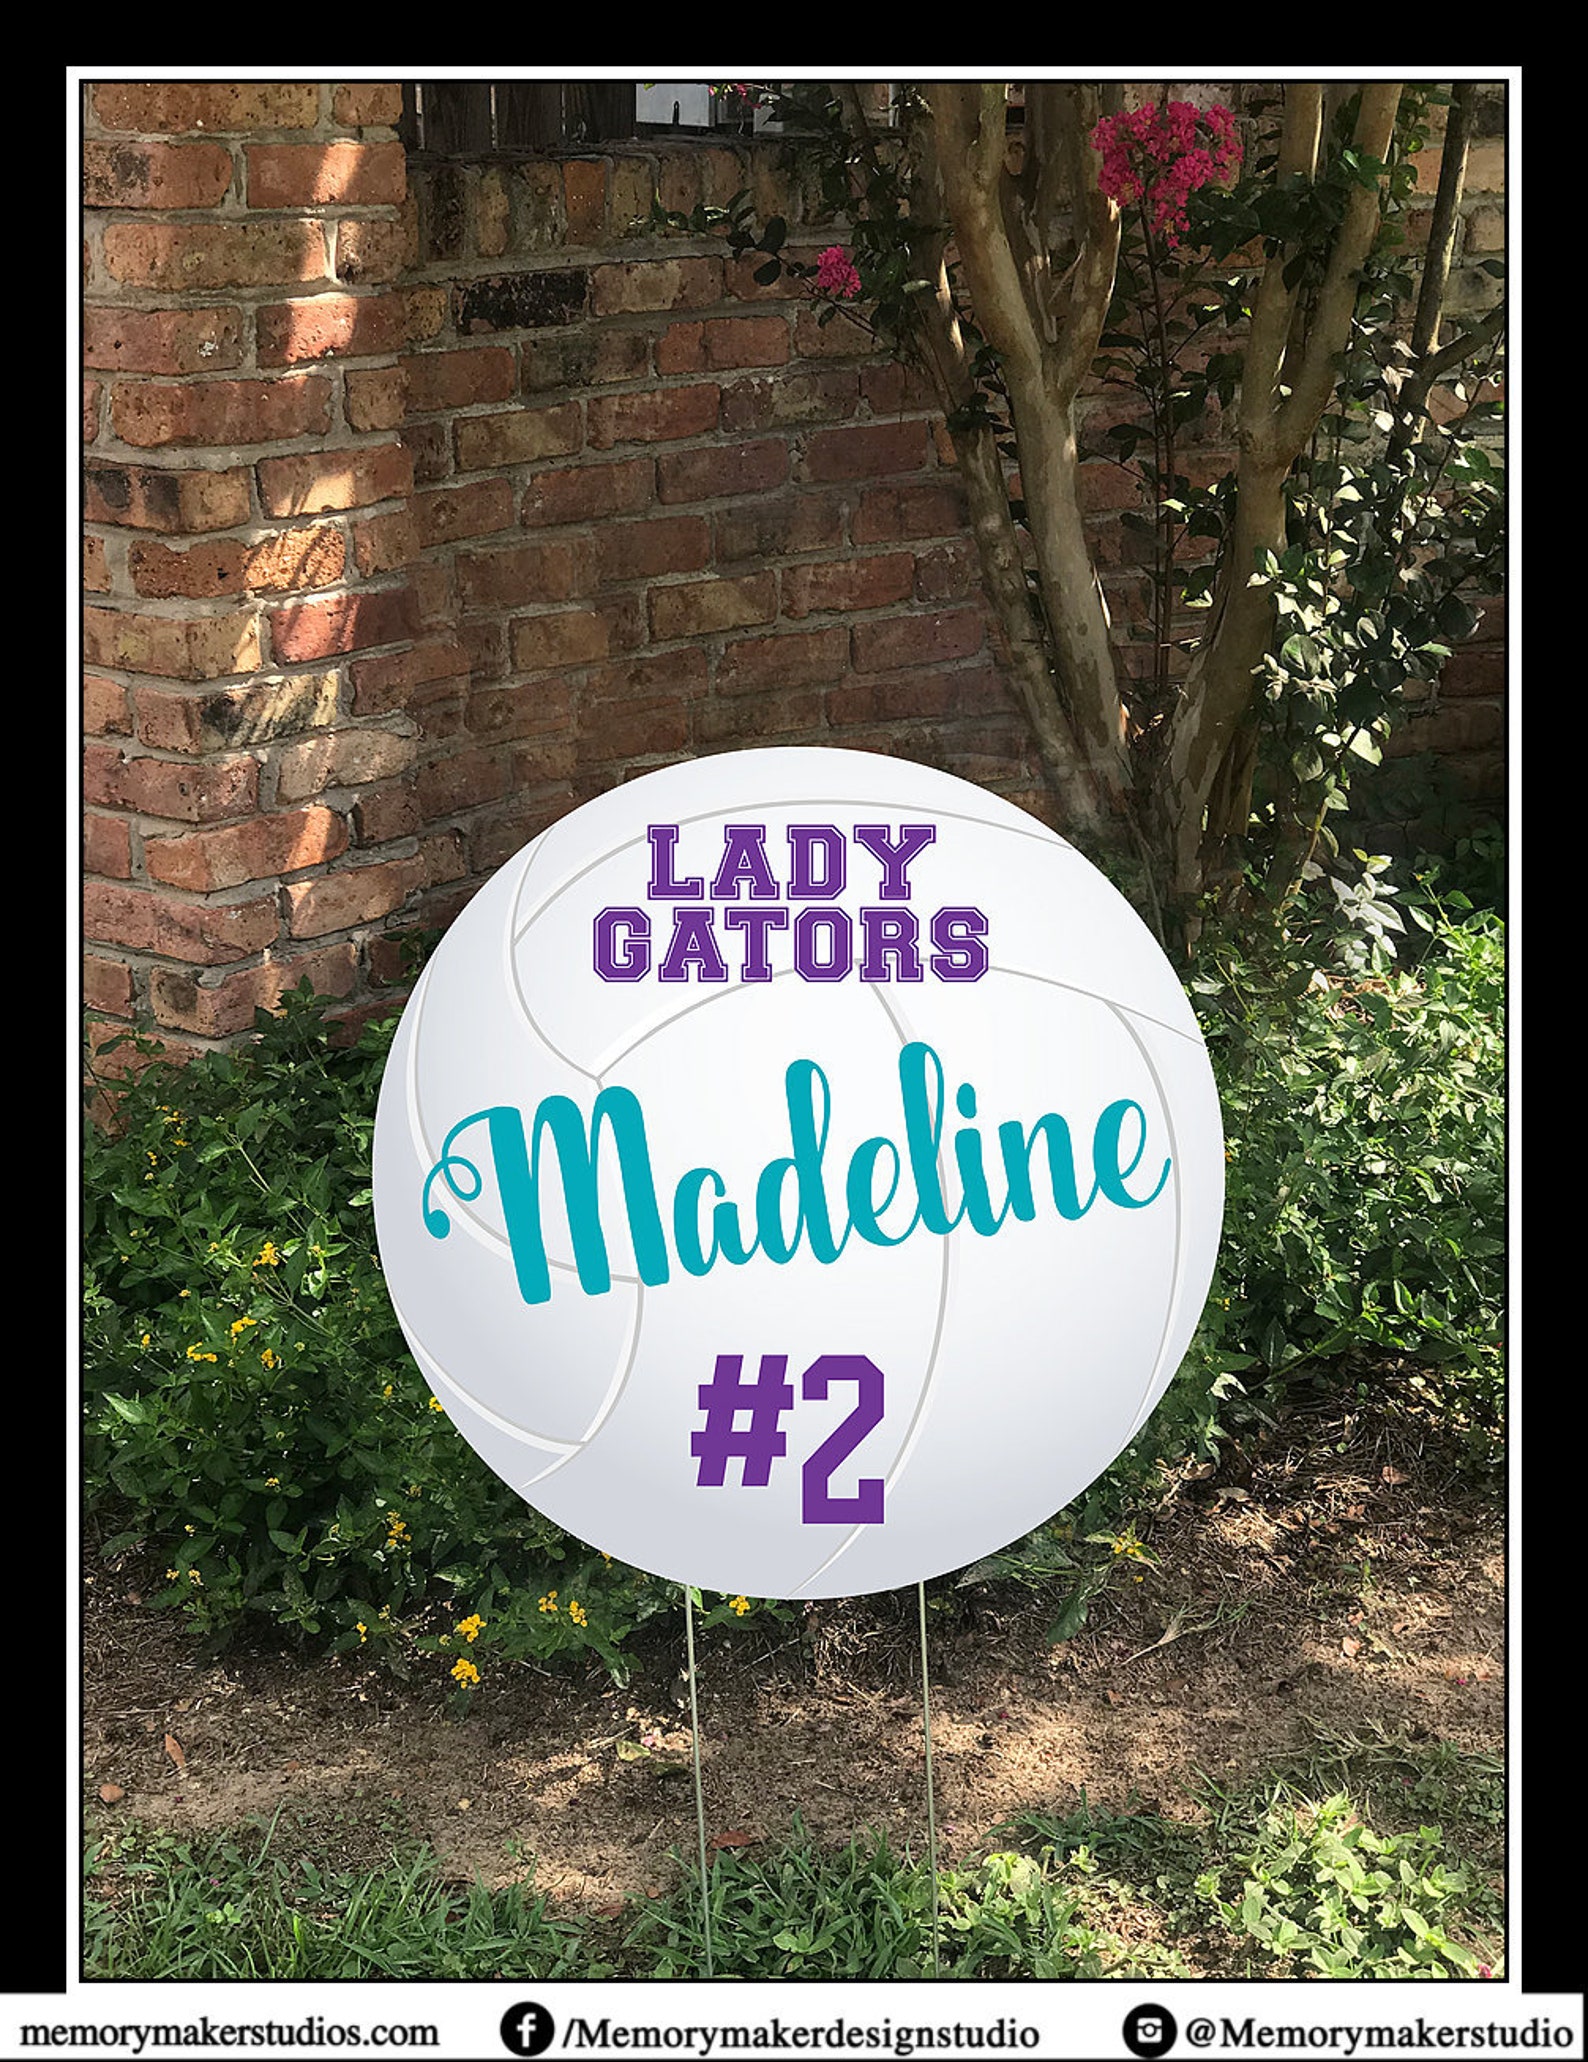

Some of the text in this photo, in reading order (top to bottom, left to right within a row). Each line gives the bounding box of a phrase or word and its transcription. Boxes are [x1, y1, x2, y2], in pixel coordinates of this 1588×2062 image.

[647, 824, 937, 901] LADY
[593, 907, 989, 983] GATORS
[423, 1041, 1172, 1305] Madeline
[690, 1354, 885, 1525] #2
